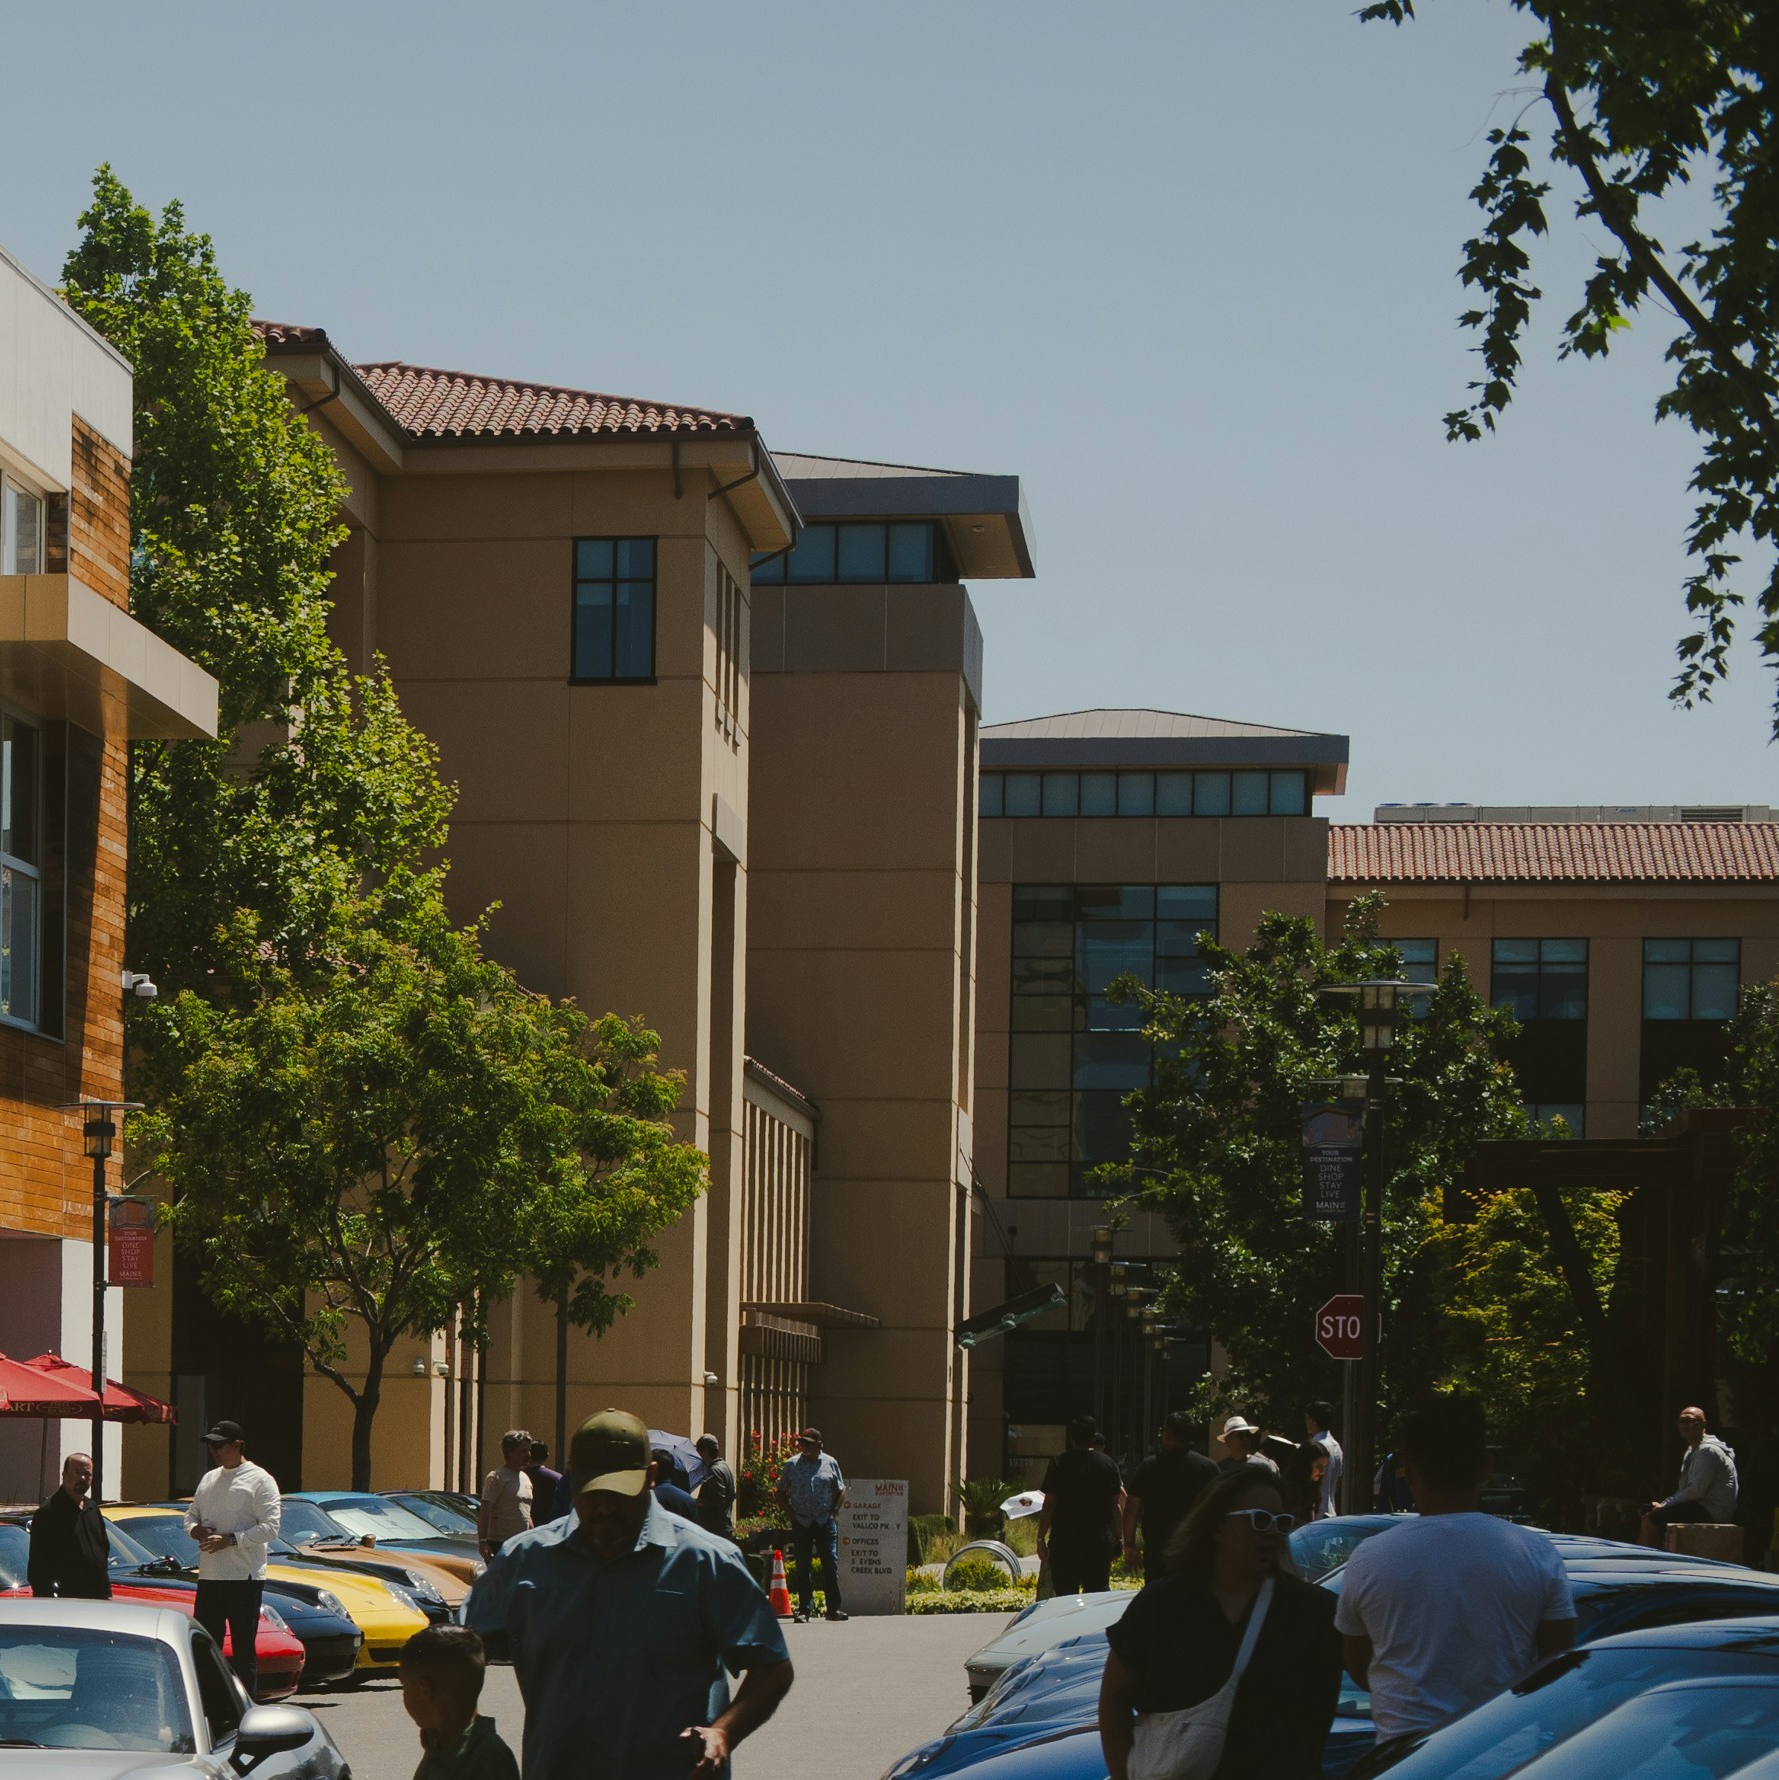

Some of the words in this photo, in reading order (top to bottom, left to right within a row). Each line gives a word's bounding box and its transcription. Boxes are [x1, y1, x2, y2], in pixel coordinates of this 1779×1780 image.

[1320, 1164, 1342, 1172] DINE
[1318, 1172, 1344, 1181] SHOP
[1319, 1181, 1341, 1189] STAY
[1320, 1190, 1340, 1198] LIVE
[1321, 1315, 1361, 1339] STO
[9, 1402, 34, 1412] ART
